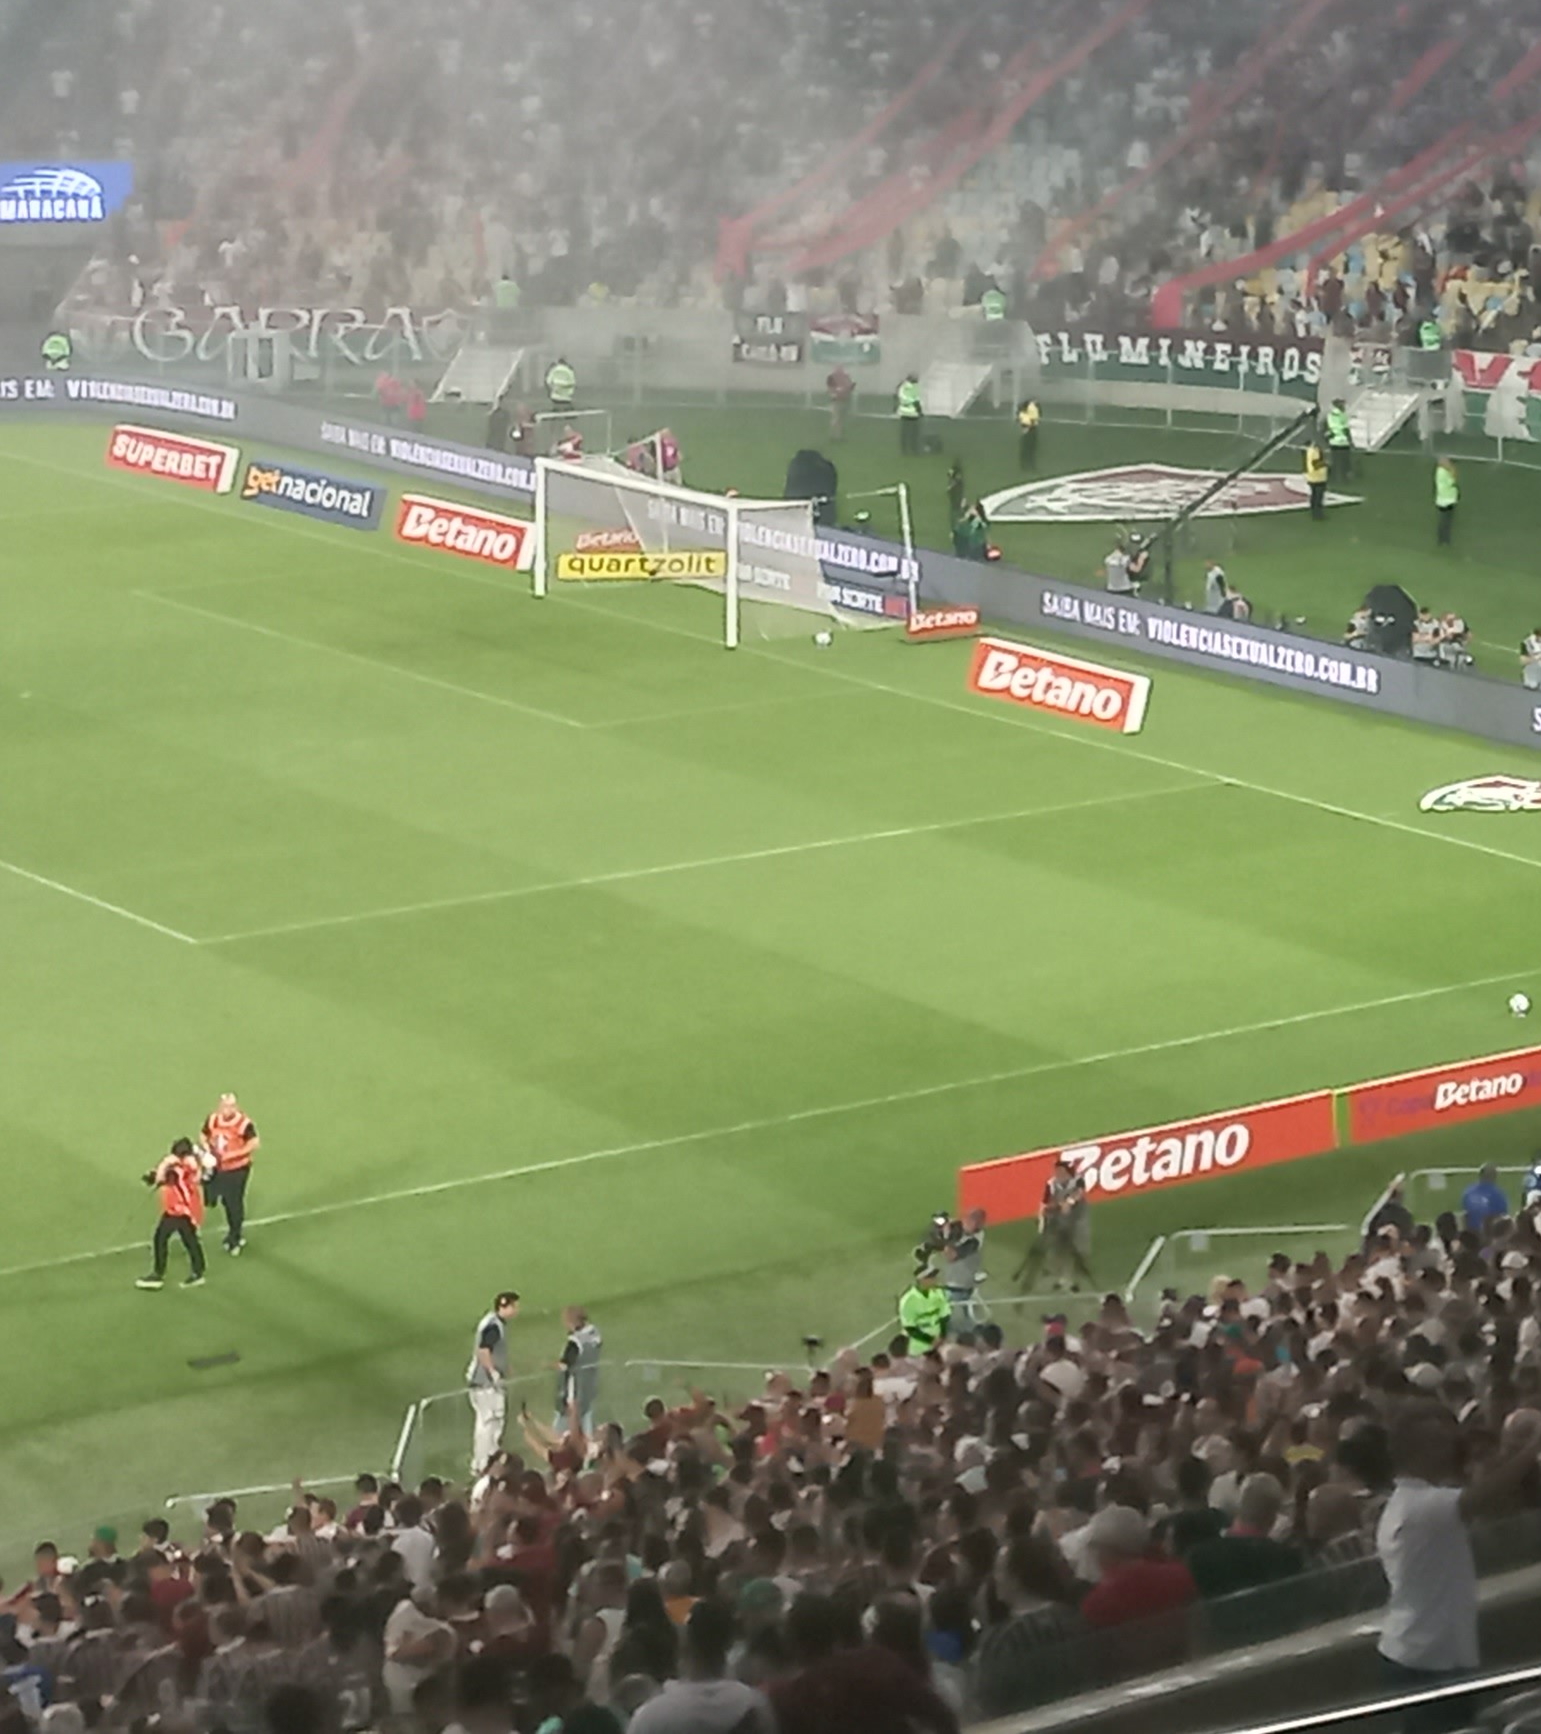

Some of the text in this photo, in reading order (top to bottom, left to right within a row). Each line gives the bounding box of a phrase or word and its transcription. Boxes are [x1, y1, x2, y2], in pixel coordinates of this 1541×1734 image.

[1036, 332, 1322, 384] FLUMINEIROS
[112, 435, 221, 479] SUPERBET
[402, 506, 517, 562] Betano
[567, 555, 717, 575] quartzolit
[910, 608, 977, 631] Betano
[1084, 602, 1116, 631] MAIS
[977, 649, 1123, 721] Betano
[1433, 1072, 1524, 1111] Betano
